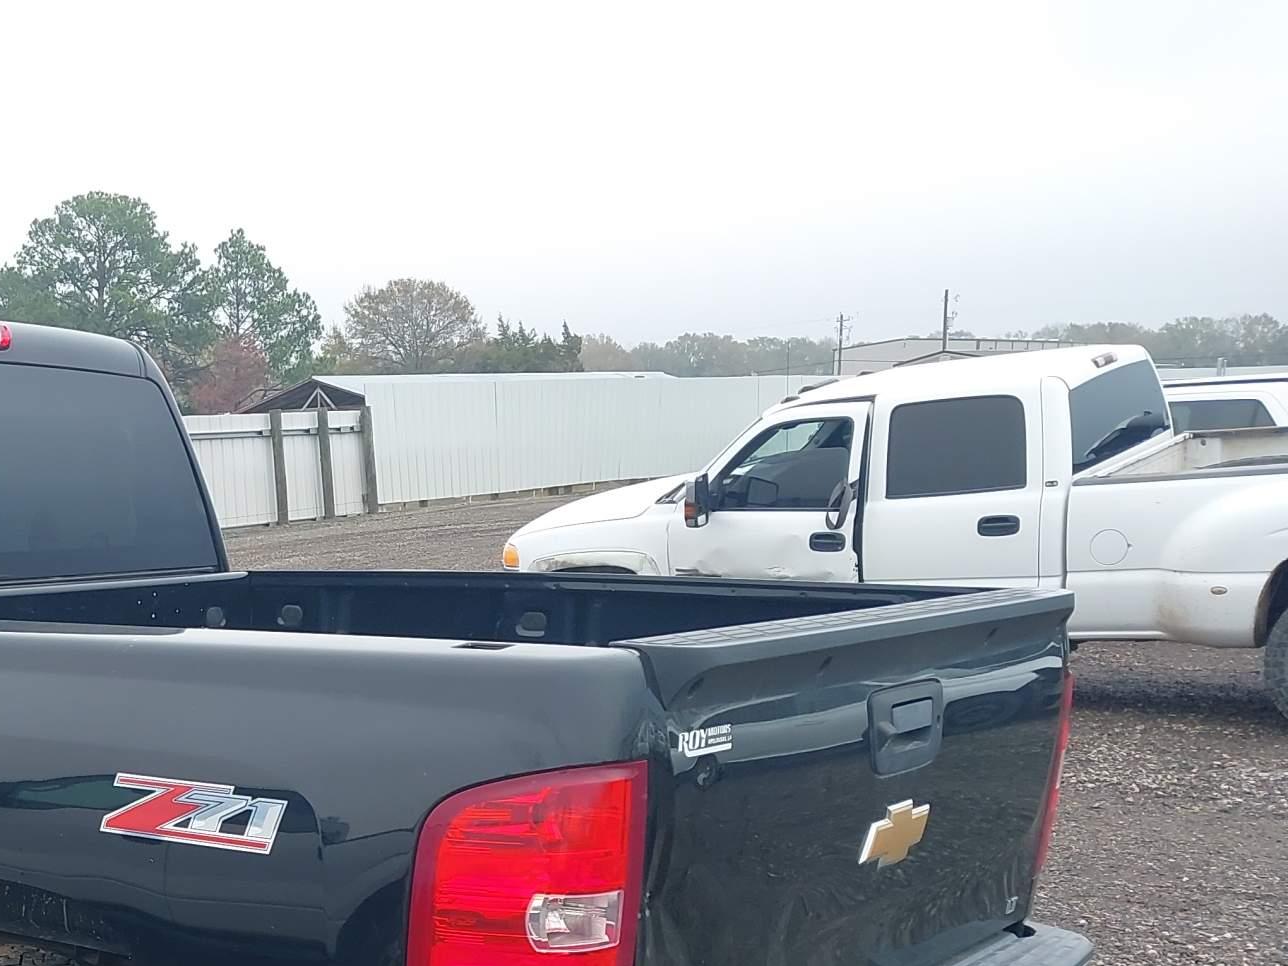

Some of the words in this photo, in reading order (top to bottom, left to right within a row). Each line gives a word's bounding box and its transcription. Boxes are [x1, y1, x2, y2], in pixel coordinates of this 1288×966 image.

[678, 729, 707, 754] ROY
[99, 772, 289, 855] Z71
[1005, 895, 1019, 915] LT
